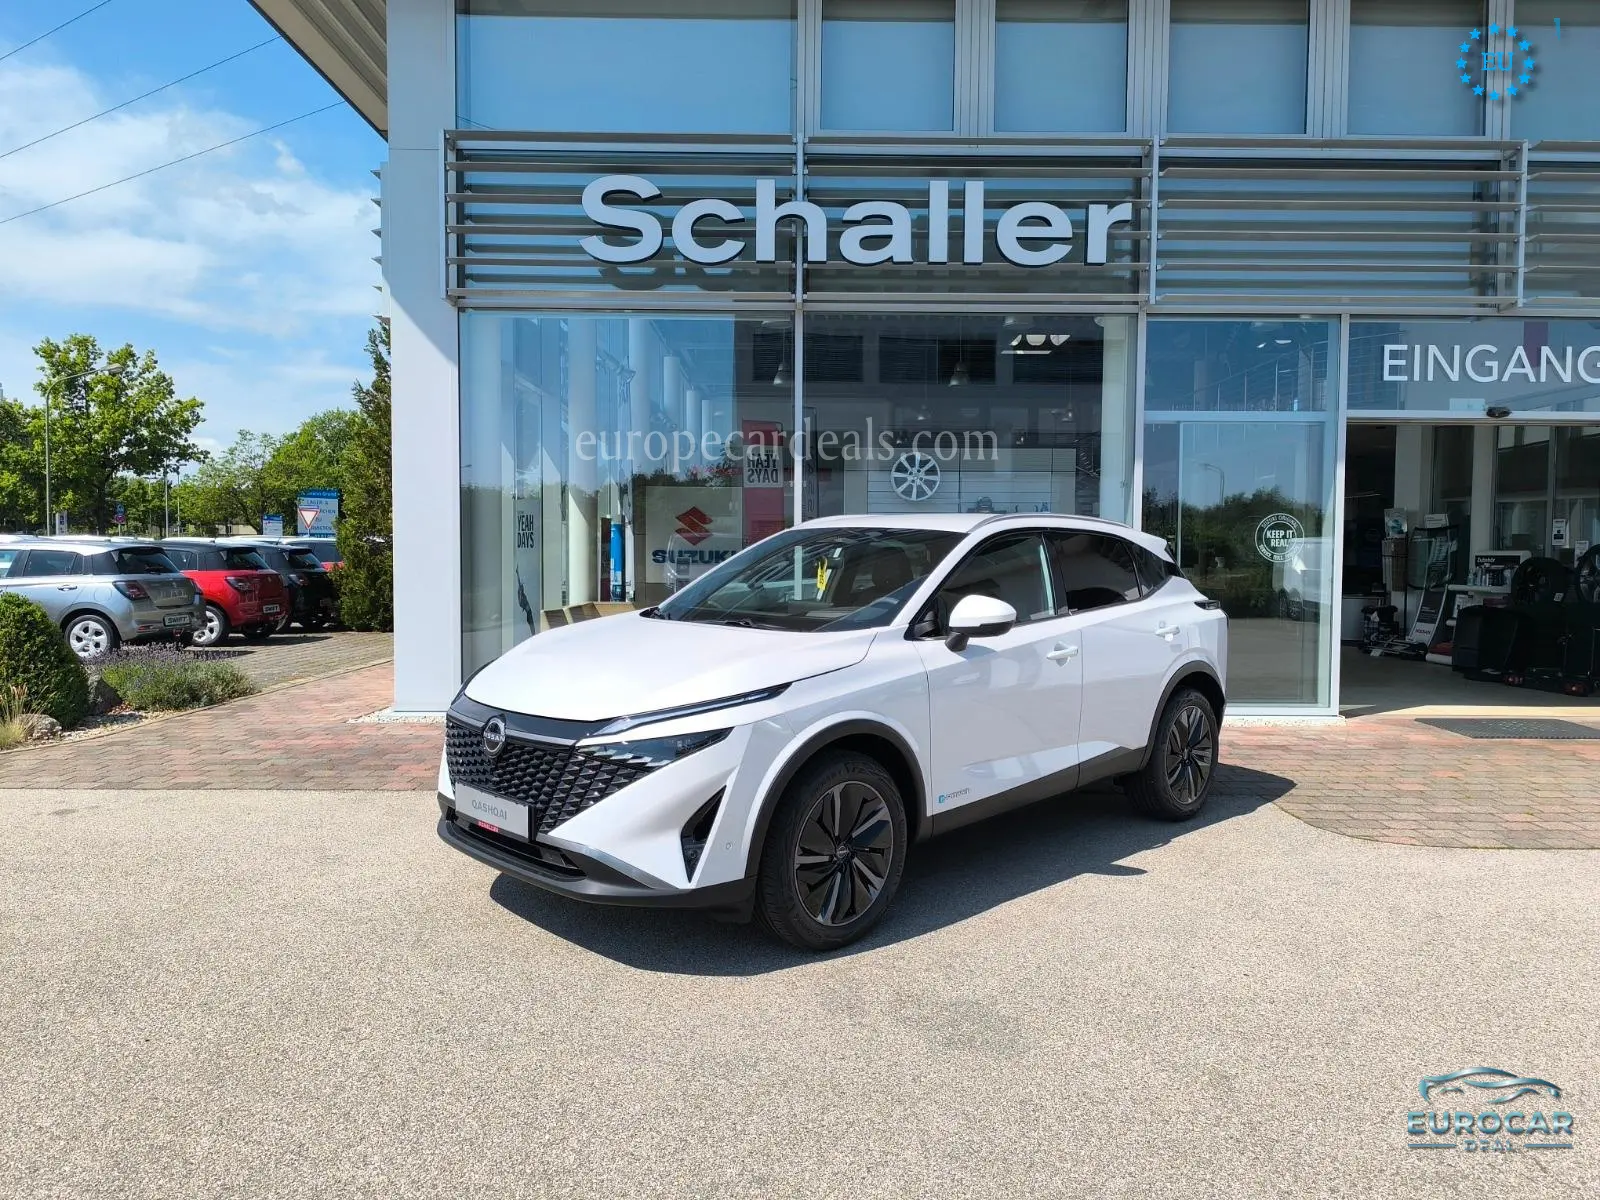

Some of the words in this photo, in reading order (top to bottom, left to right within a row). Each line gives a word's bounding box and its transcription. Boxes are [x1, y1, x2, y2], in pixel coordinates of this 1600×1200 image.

[578, 174, 1133, 266] Schaller
[1383, 344, 1600, 384] EINGANG
[517, 514, 534, 532] YEAH
[517, 531, 535, 549] DAYS
[1266, 529, 1285, 539] KEEP
[1286, 529, 1294, 539] IT
[1270, 538, 1289, 548] REAL
[167, 614, 187, 624] SWIFT
[483, 732, 505, 741] NISSAN
[471, 799, 508, 820] QASHQAI
